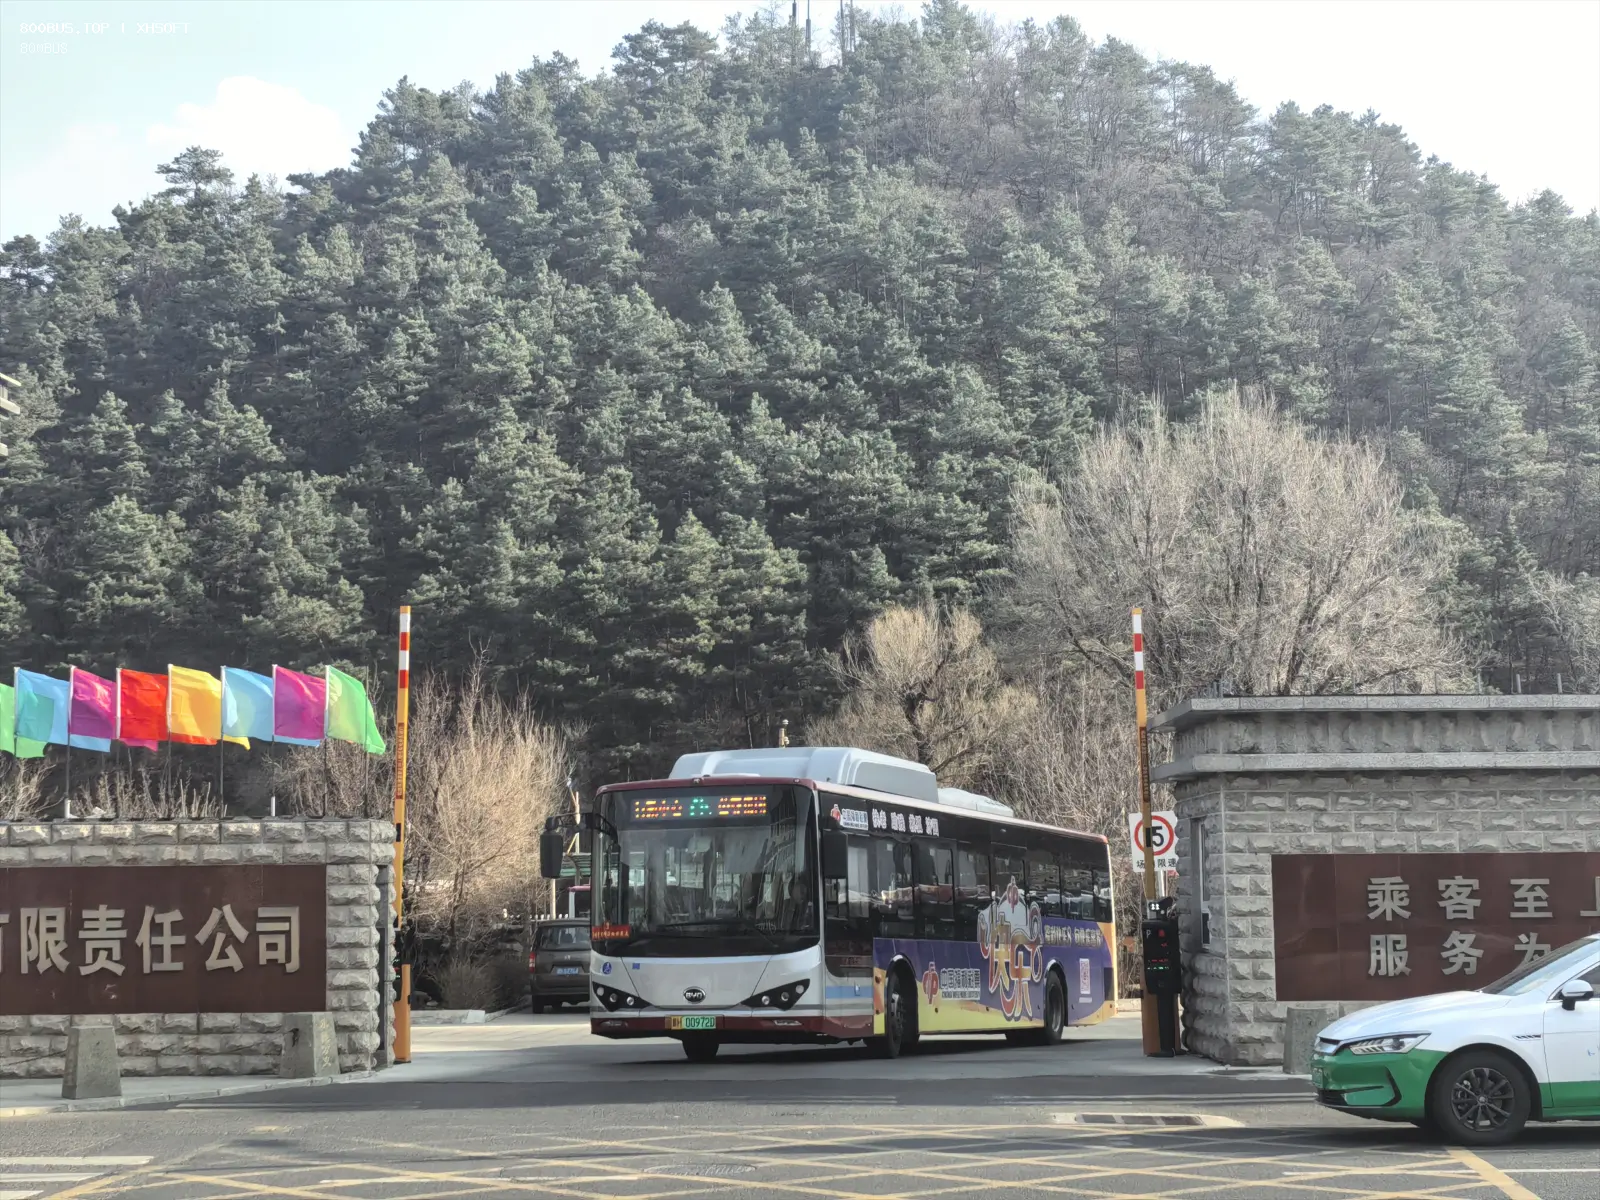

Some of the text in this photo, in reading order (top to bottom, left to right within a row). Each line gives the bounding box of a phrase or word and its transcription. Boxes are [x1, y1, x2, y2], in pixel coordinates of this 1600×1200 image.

[1136, 858, 1177, 869] 场限速
[0, 904, 300, 977] 限责任公司
